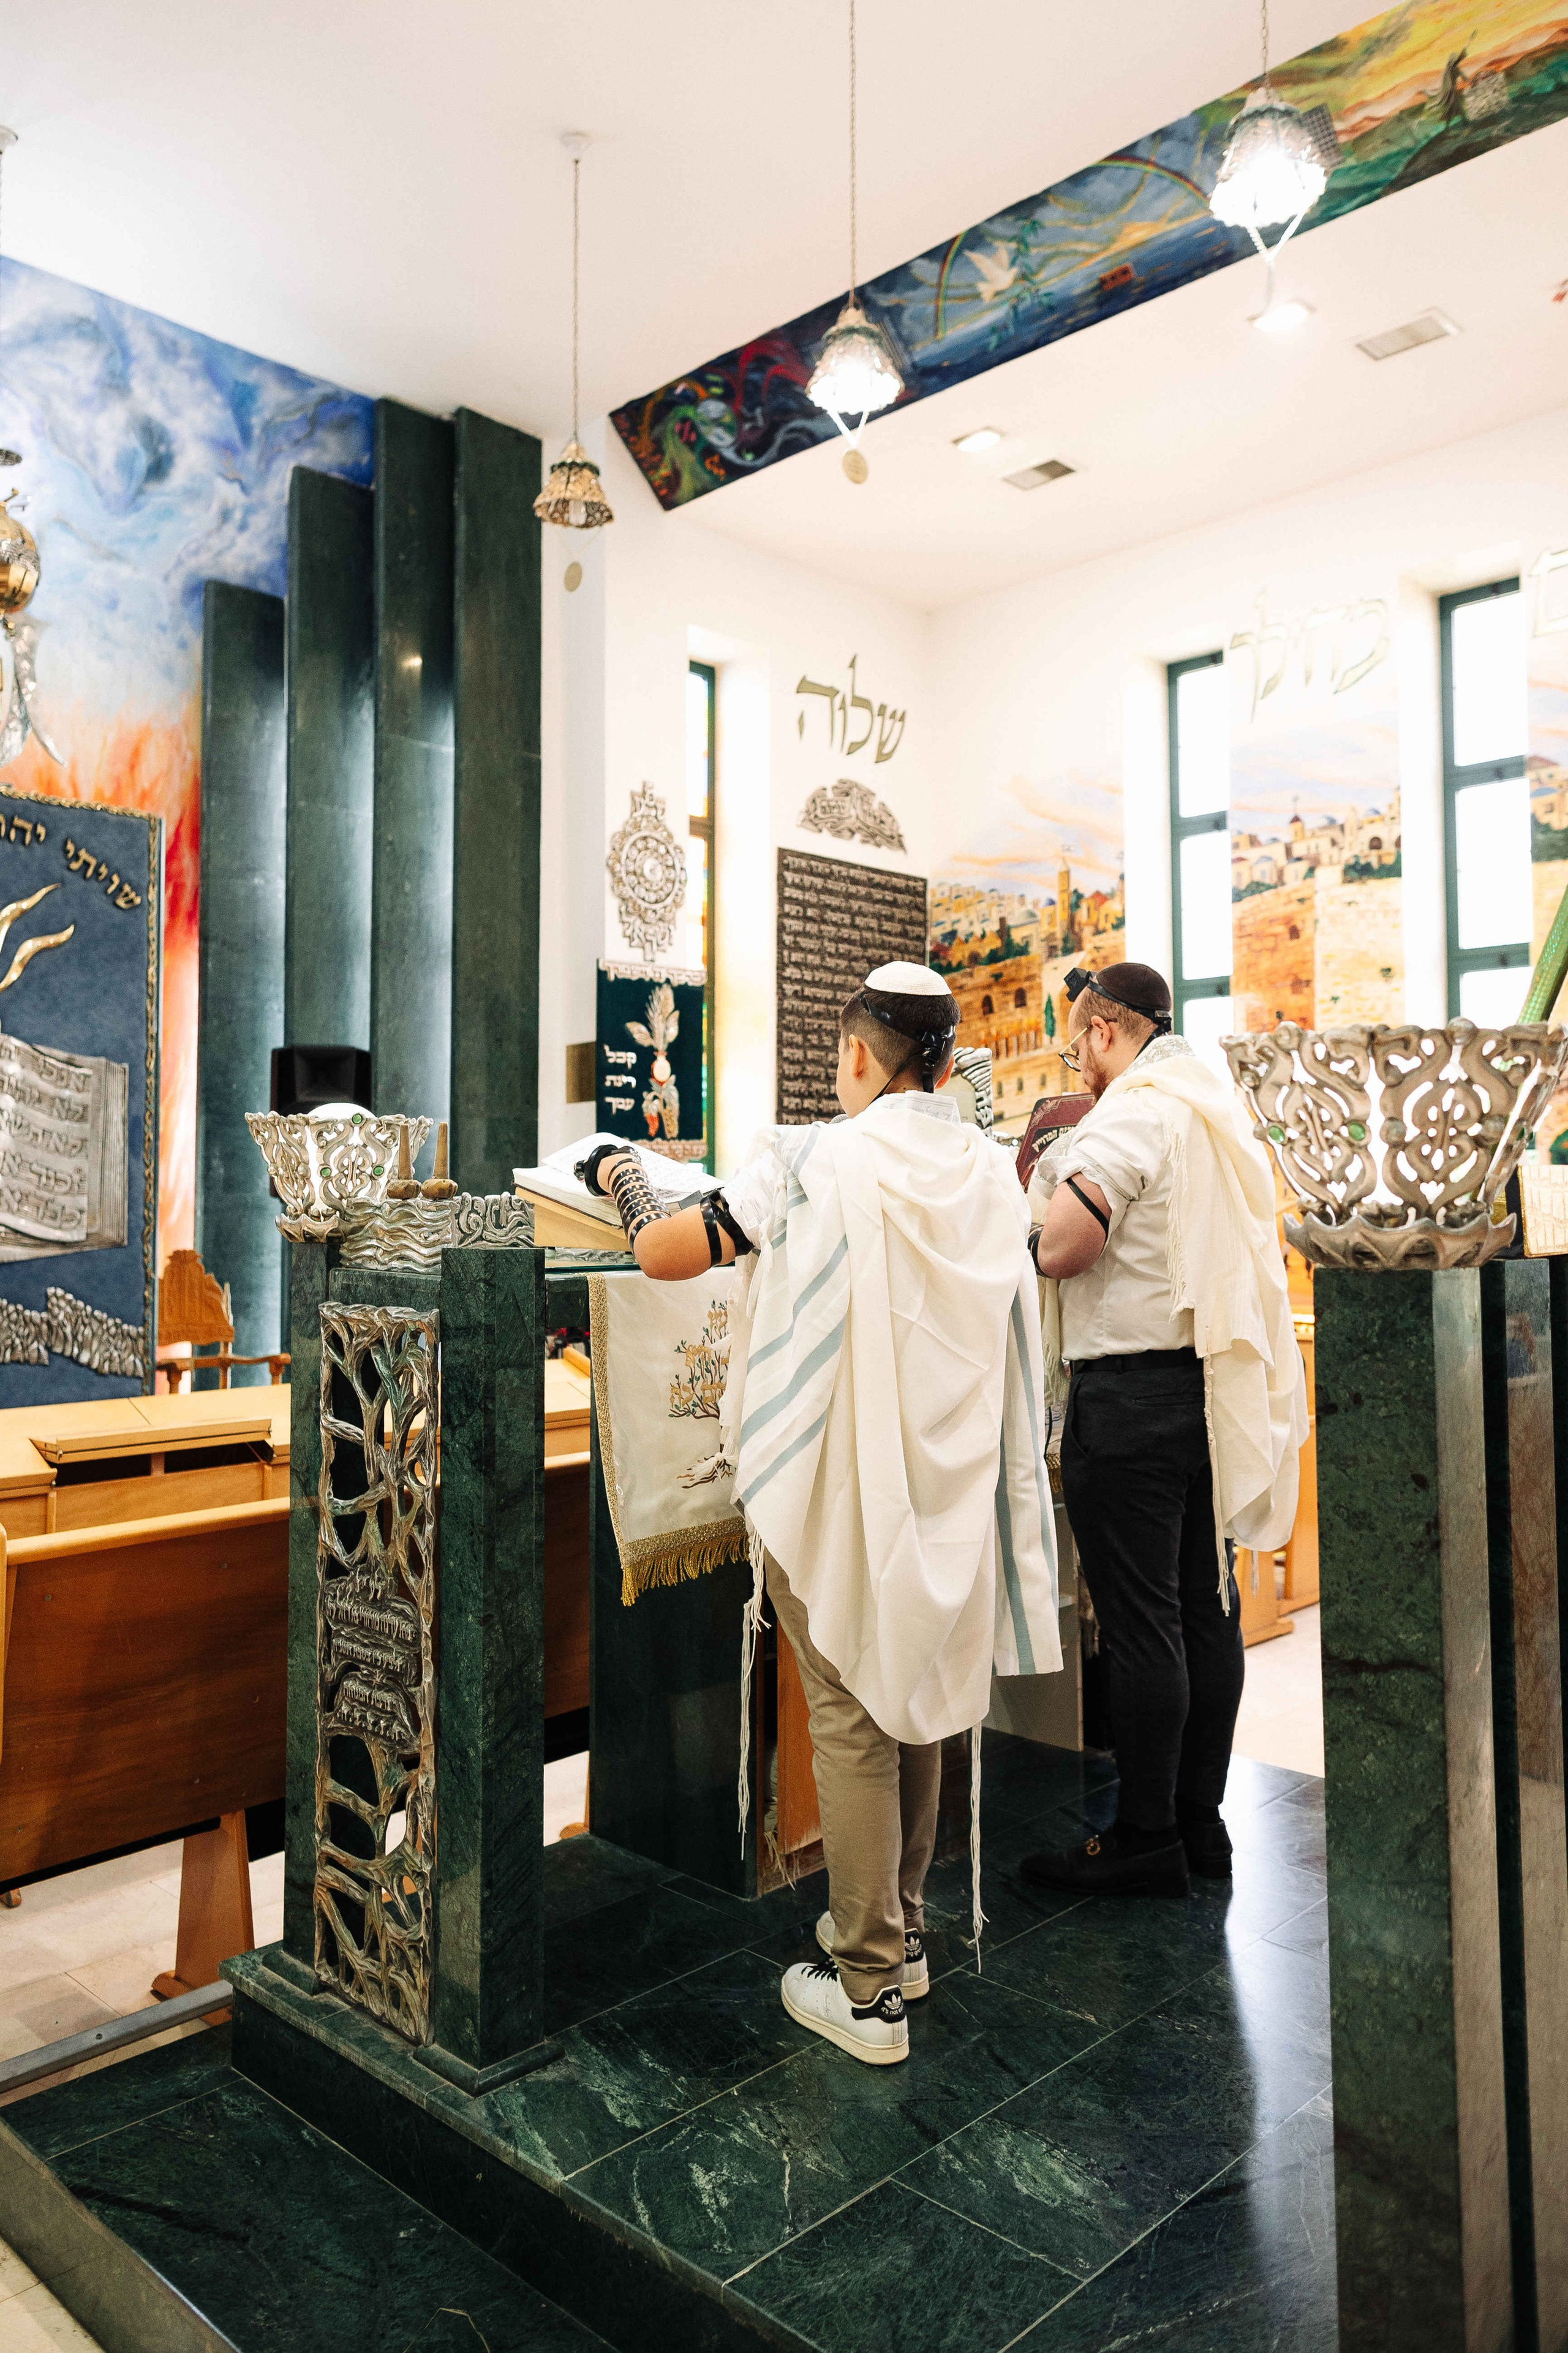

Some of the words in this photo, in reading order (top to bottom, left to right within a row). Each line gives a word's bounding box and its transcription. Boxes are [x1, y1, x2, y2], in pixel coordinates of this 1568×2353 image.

[796, 654, 906, 763] שלוה
[0, 814, 46, 846] יהו
[65, 837, 141, 910] שויתי
[603, 1044, 637, 1070] קבל
[604, 1097, 635, 1116] עמך
